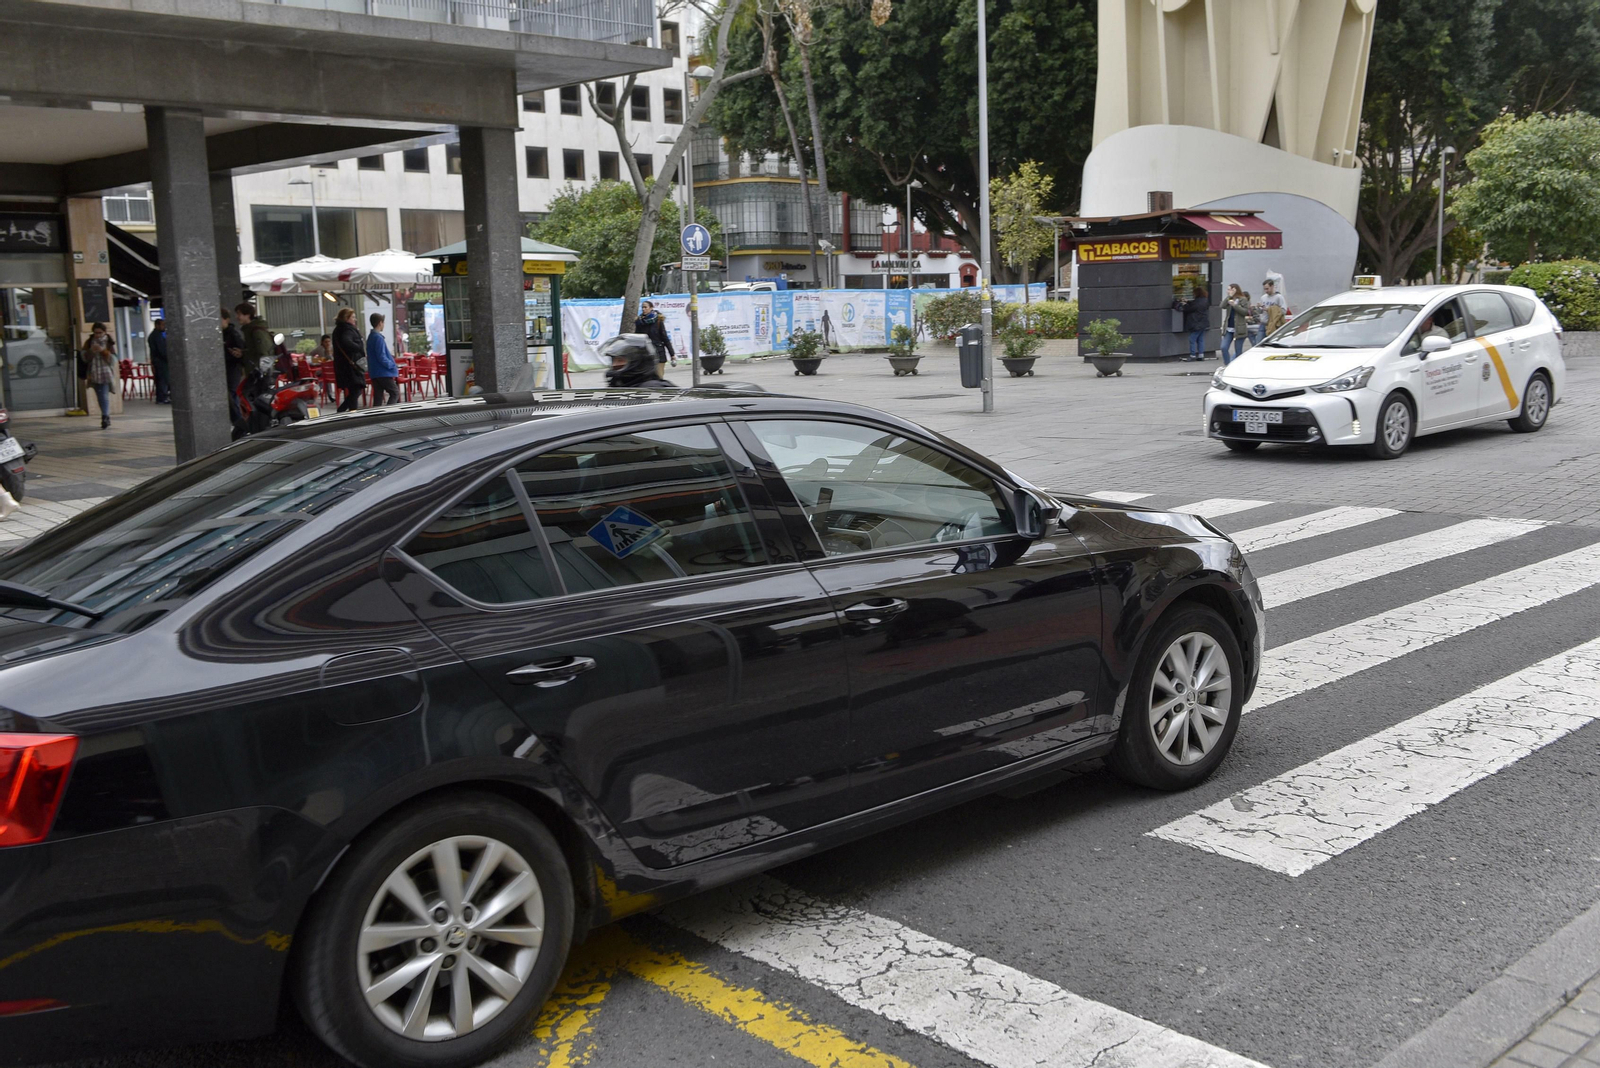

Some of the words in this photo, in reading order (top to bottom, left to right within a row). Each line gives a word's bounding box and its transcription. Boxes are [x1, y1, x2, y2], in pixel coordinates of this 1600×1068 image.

[1180, 237, 1209, 252] TABAC
[1223, 236, 1267, 249] TABACOS
[1093, 241, 1159, 256] TABACOS
[871, 260, 881, 269] LA
[1261, 412, 1281, 422] KGC
[1248, 422, 1265, 432] SP
